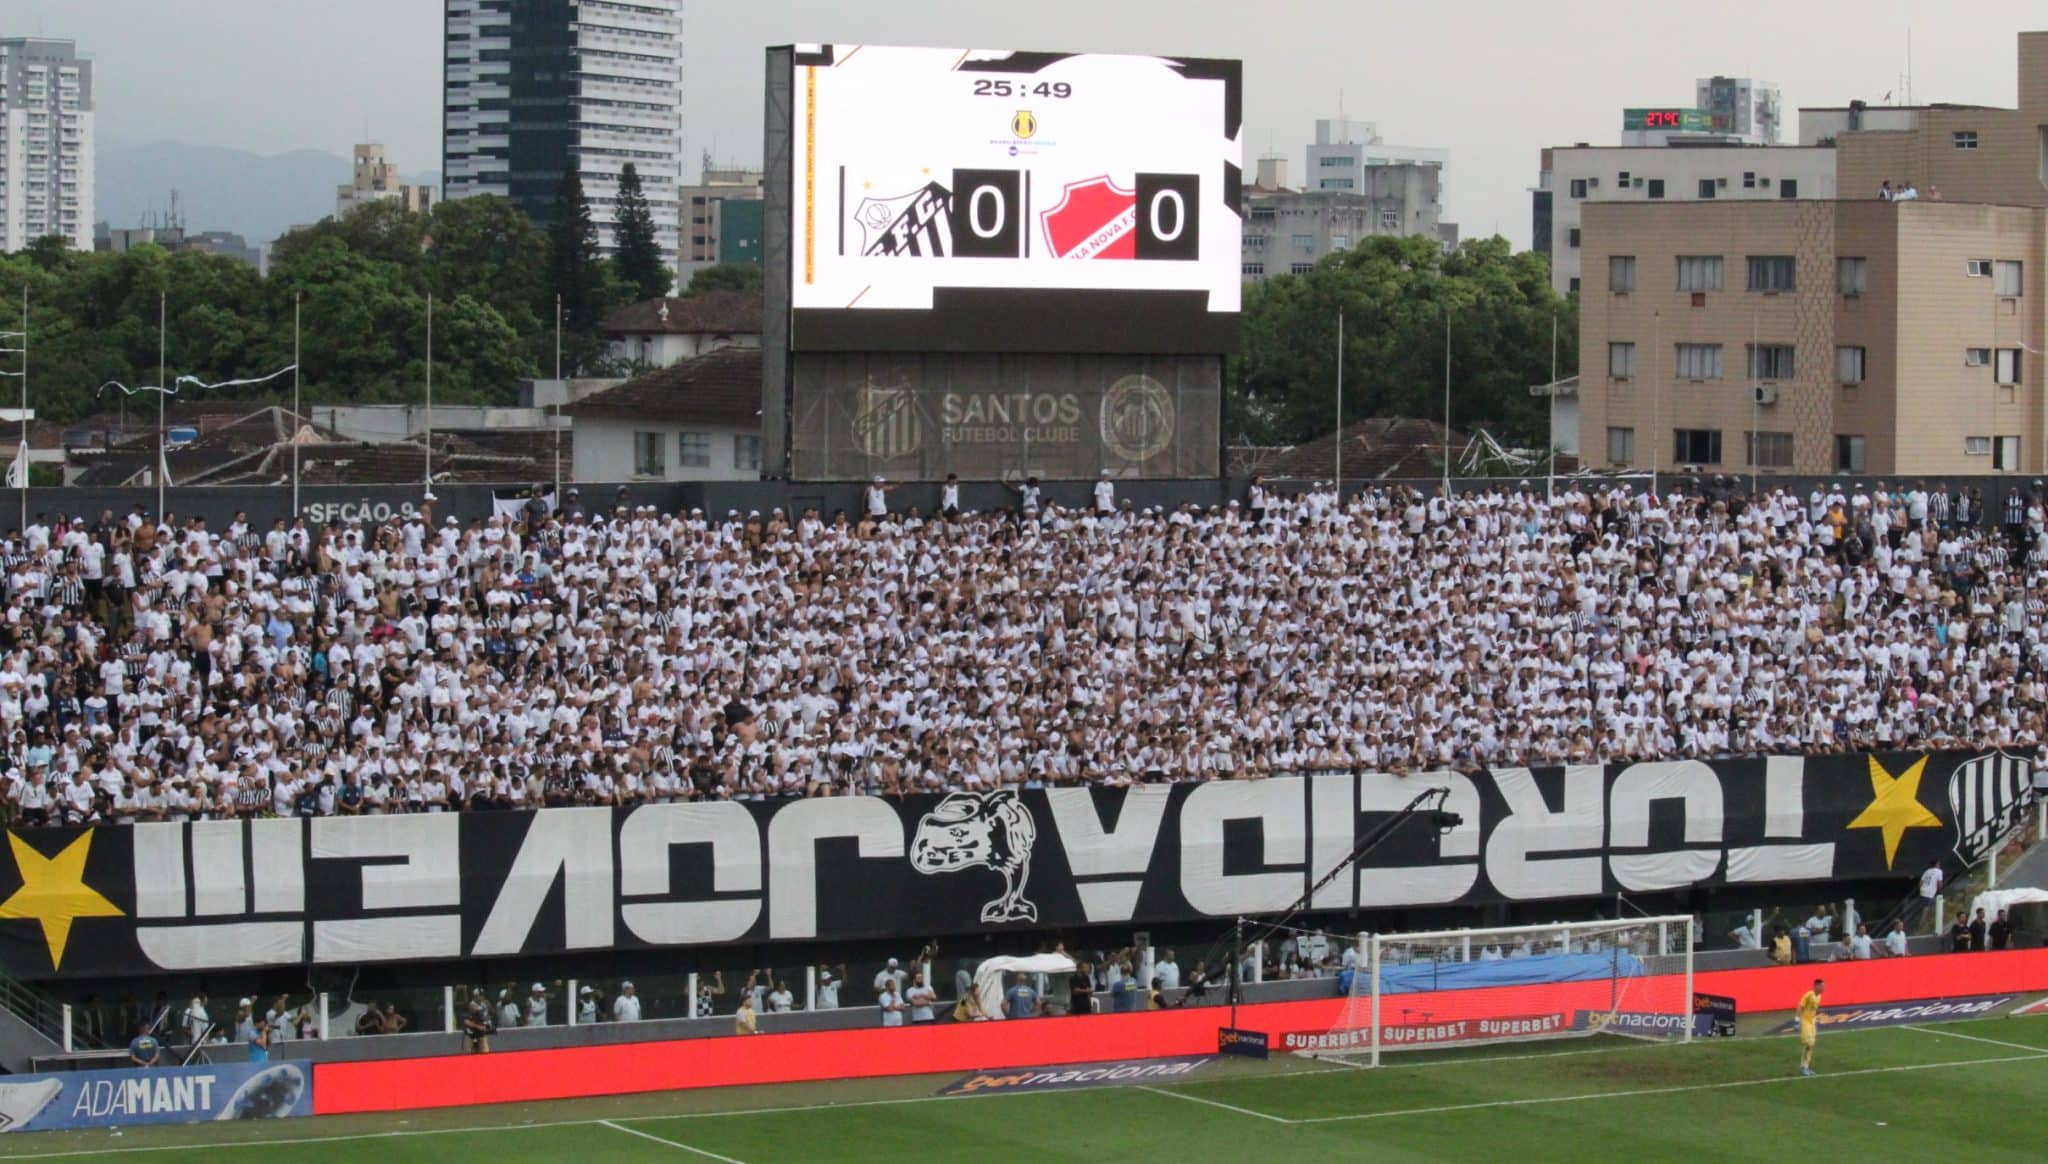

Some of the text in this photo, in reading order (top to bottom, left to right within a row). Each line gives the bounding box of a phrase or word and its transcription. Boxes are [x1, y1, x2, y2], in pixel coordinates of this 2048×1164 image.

[974, 79, 1072, 98] 25:49
[969, 184, 1006, 238] 0
[1150, 189, 1185, 241] 0
[1090, 225, 1122, 248] NOVA
[942, 394, 1080, 424] SANTOS
[943, 427, 1080, 442] FUTEBOL CLUBE
[133, 756, 1836, 970] TORCIDA JOVEM
[1384, 1022, 1466, 1041] SUPERBET
[1480, 1014, 1561, 1034] SUPERBET
[1286, 1029, 1369, 1048] SUPERBET
[73, 1075, 216, 1117] ADAMANT
